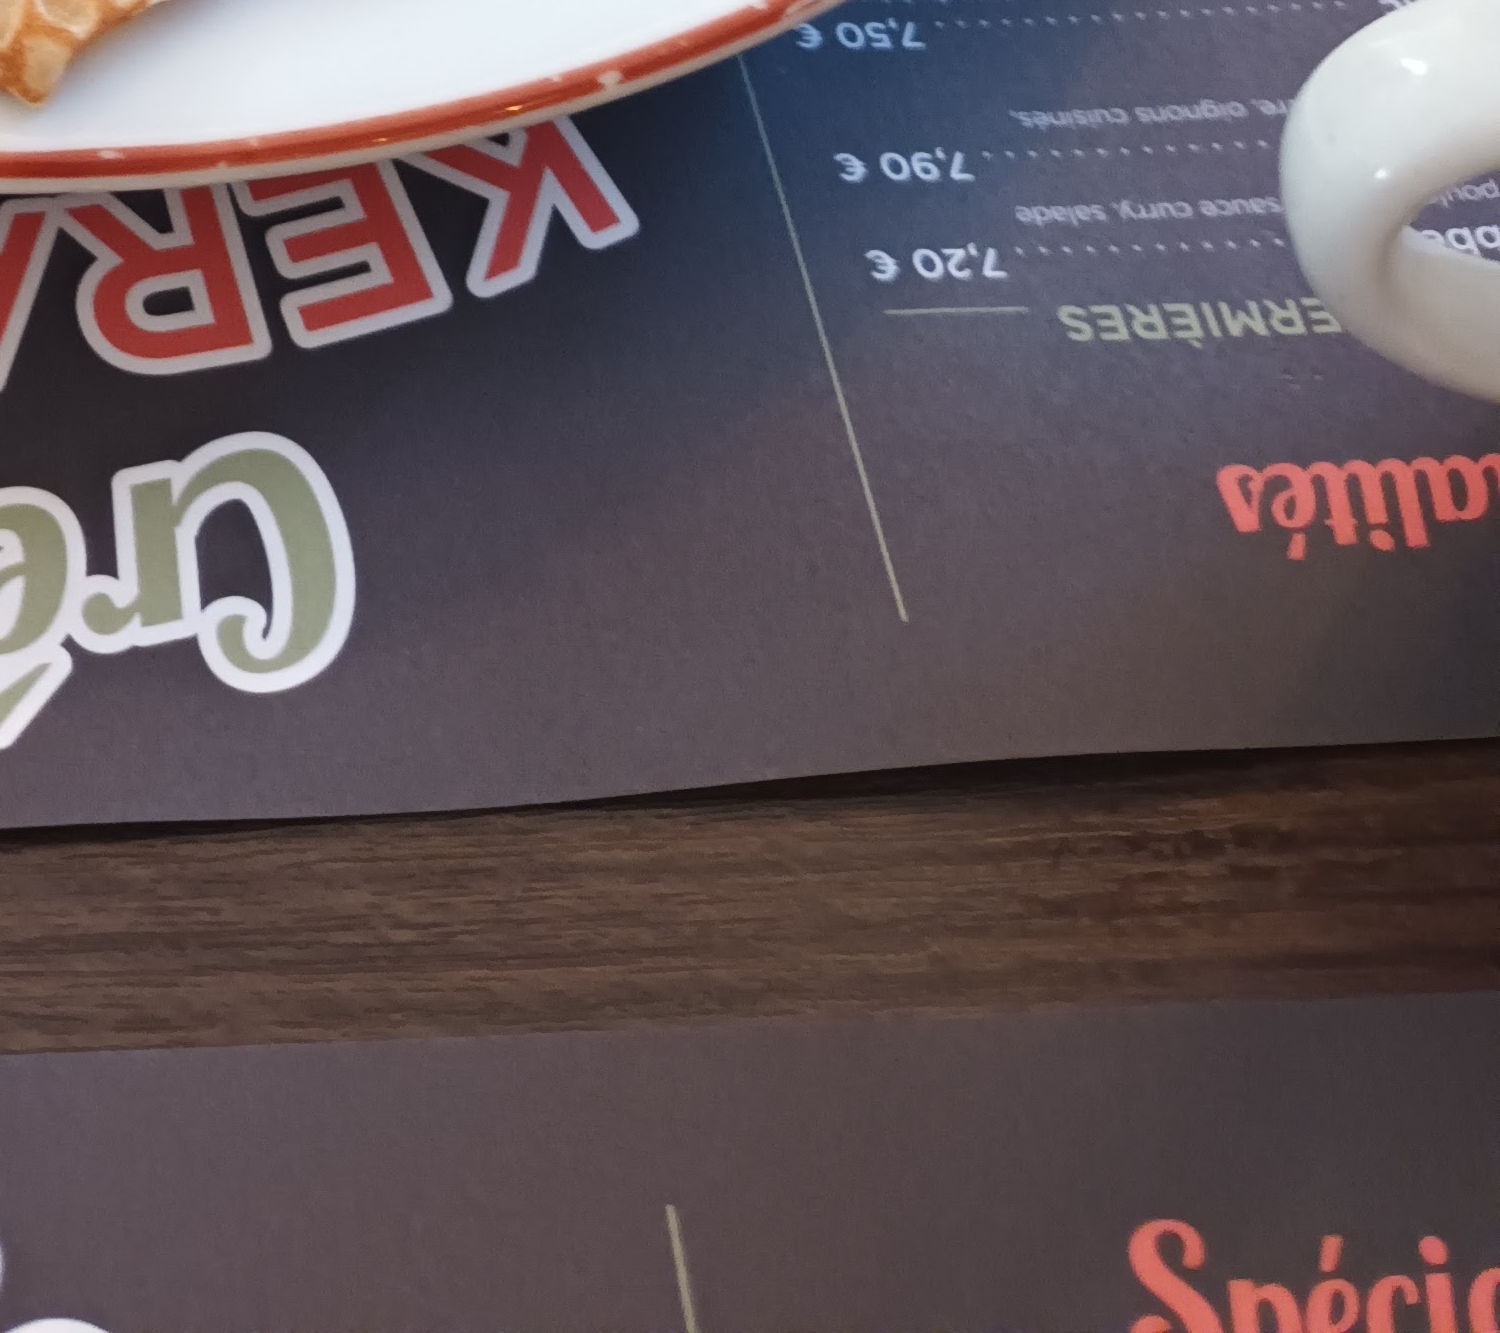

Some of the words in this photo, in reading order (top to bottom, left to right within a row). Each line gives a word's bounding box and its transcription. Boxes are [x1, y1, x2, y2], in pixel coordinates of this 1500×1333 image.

[794, 21, 824, 50] €
[836, 17, 927, 50] 7,50
[1134, 98, 1248, 123] oignons
[833, 152, 868, 183] €
[879, 146, 975, 182] 7,90
[1013, 204, 1107, 228] salade
[1199, 195, 1283, 218] sauce
[864, 249, 900, 283] €
[912, 242, 1009, 281] 7,20
[1215, 453, 1500, 561] alités
